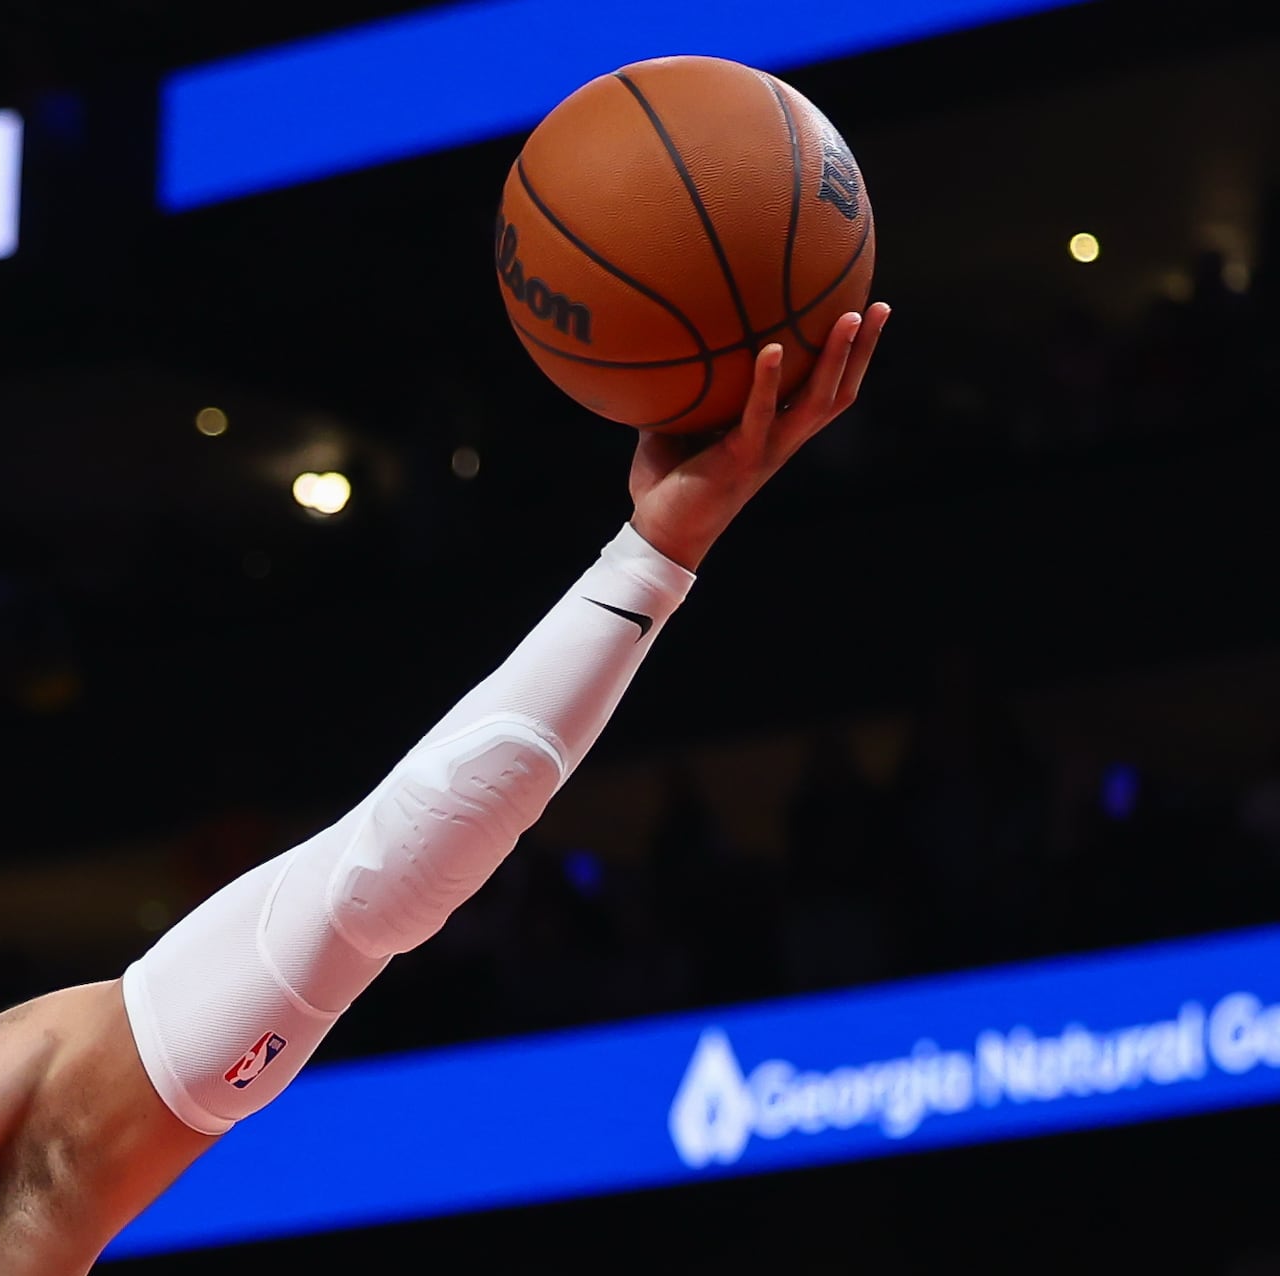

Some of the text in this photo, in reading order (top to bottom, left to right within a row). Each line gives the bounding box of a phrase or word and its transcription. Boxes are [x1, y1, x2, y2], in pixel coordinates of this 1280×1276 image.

[745, 990, 1280, 1138] Georgia Natural Ga
